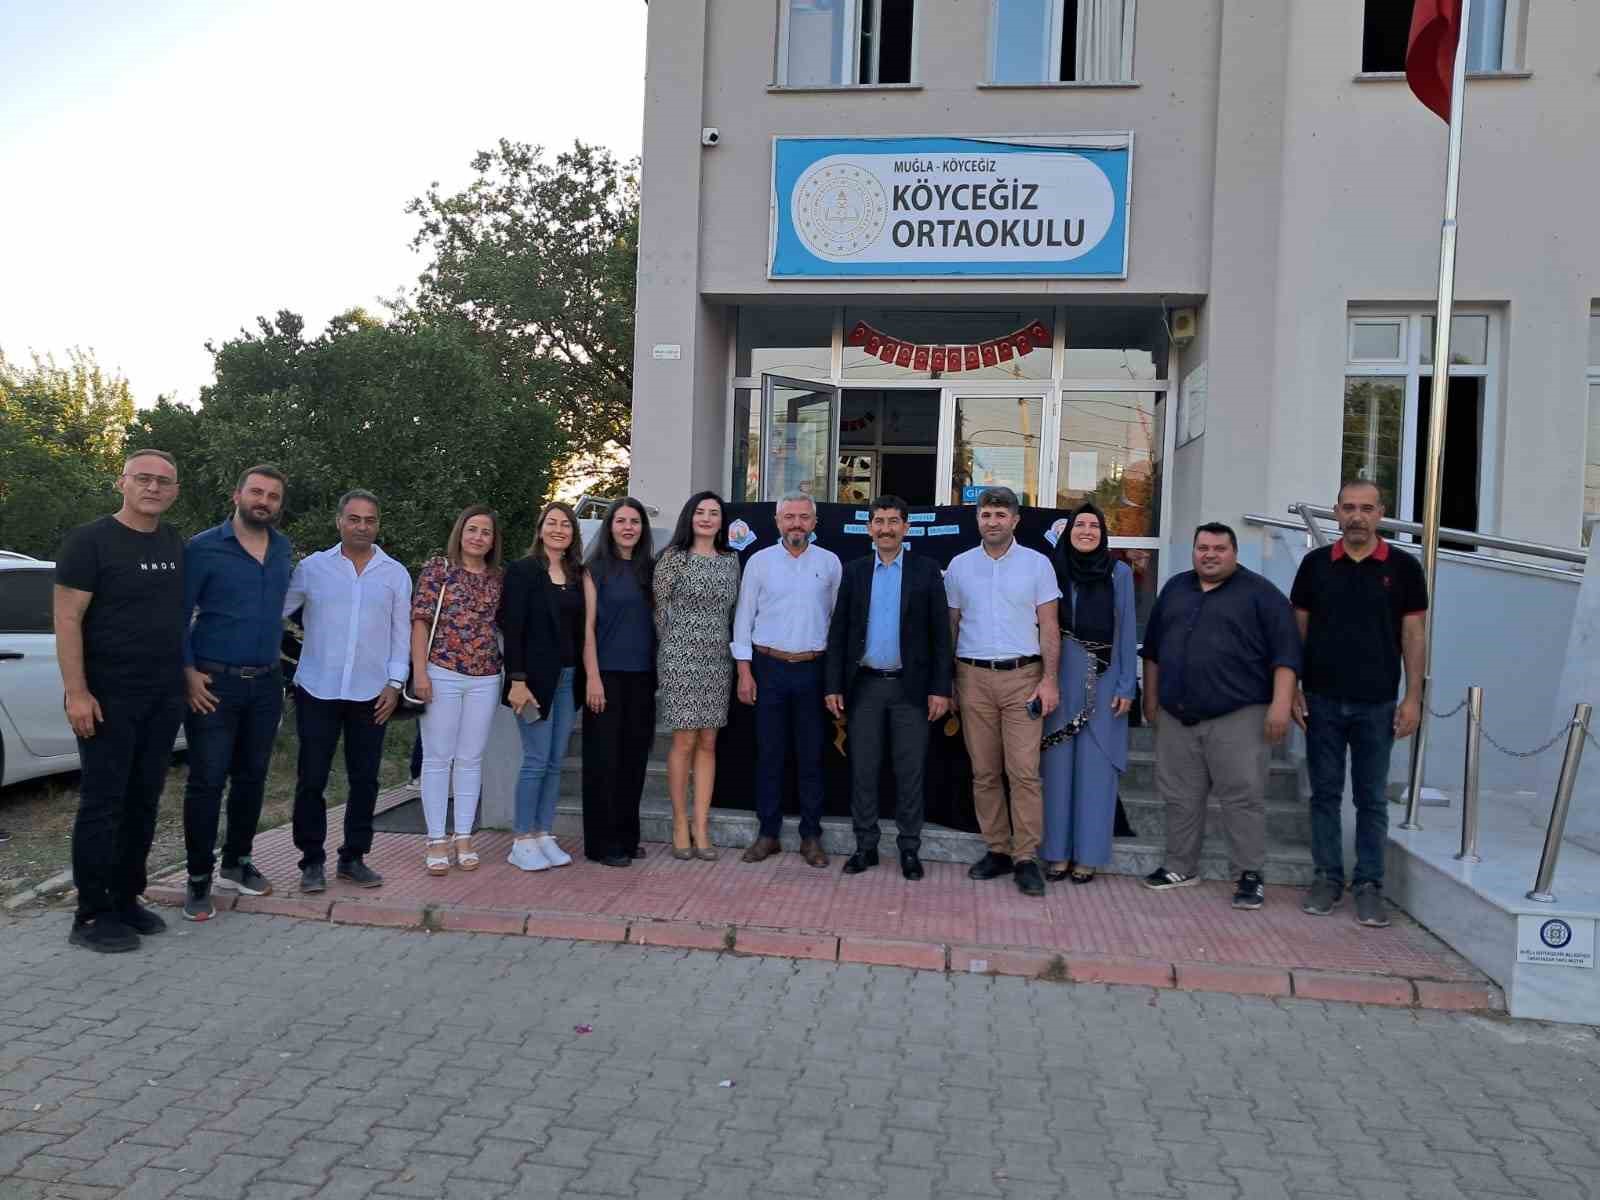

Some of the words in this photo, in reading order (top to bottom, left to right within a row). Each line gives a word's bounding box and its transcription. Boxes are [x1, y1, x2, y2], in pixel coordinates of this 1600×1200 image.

[893, 157, 934, 173] MUĞLA
[942, 157, 996, 173] KÖYCEĞİZ
[892, 178, 1039, 211] KÖYCEĞİZ
[892, 218, 1085, 248] ORTAOKULU
